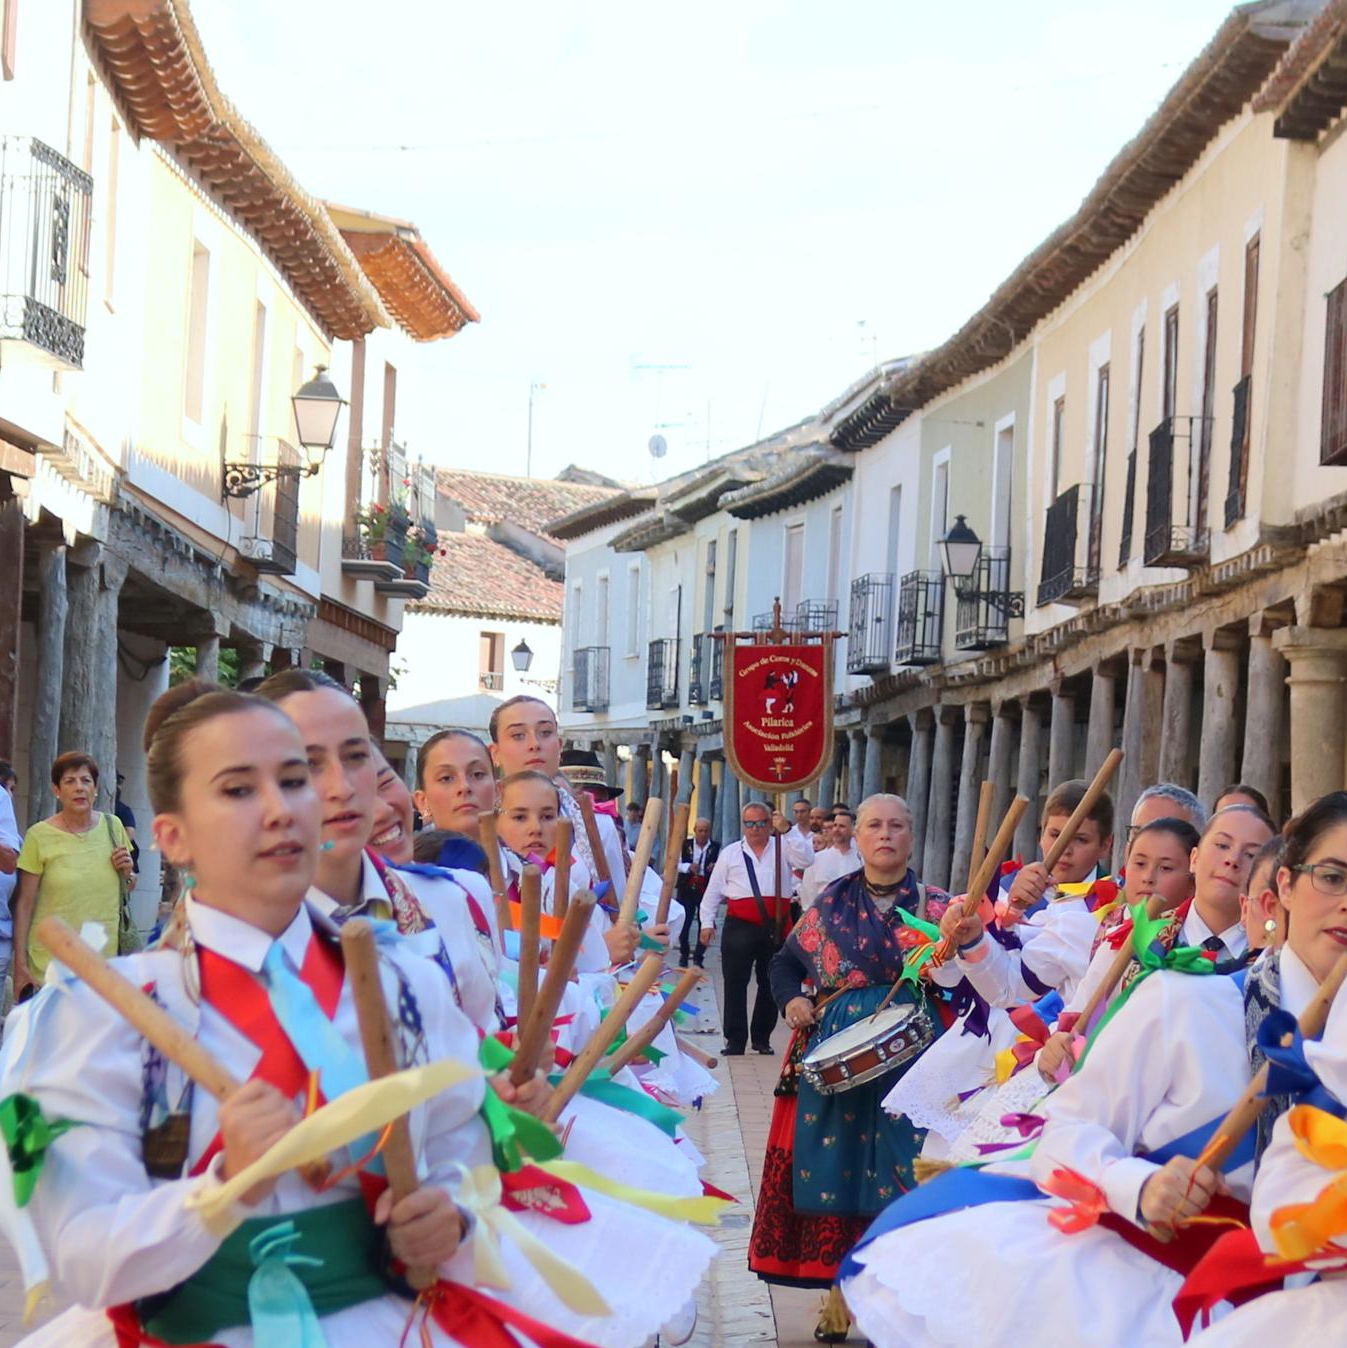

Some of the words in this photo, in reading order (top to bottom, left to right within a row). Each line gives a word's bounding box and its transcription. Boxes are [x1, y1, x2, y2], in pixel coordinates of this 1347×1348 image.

[739, 662, 760, 677] Grupo
[760, 657, 769, 665] de
[761, 716, 794, 727] Pilarica
[763, 743, 794, 752] Valladolid
